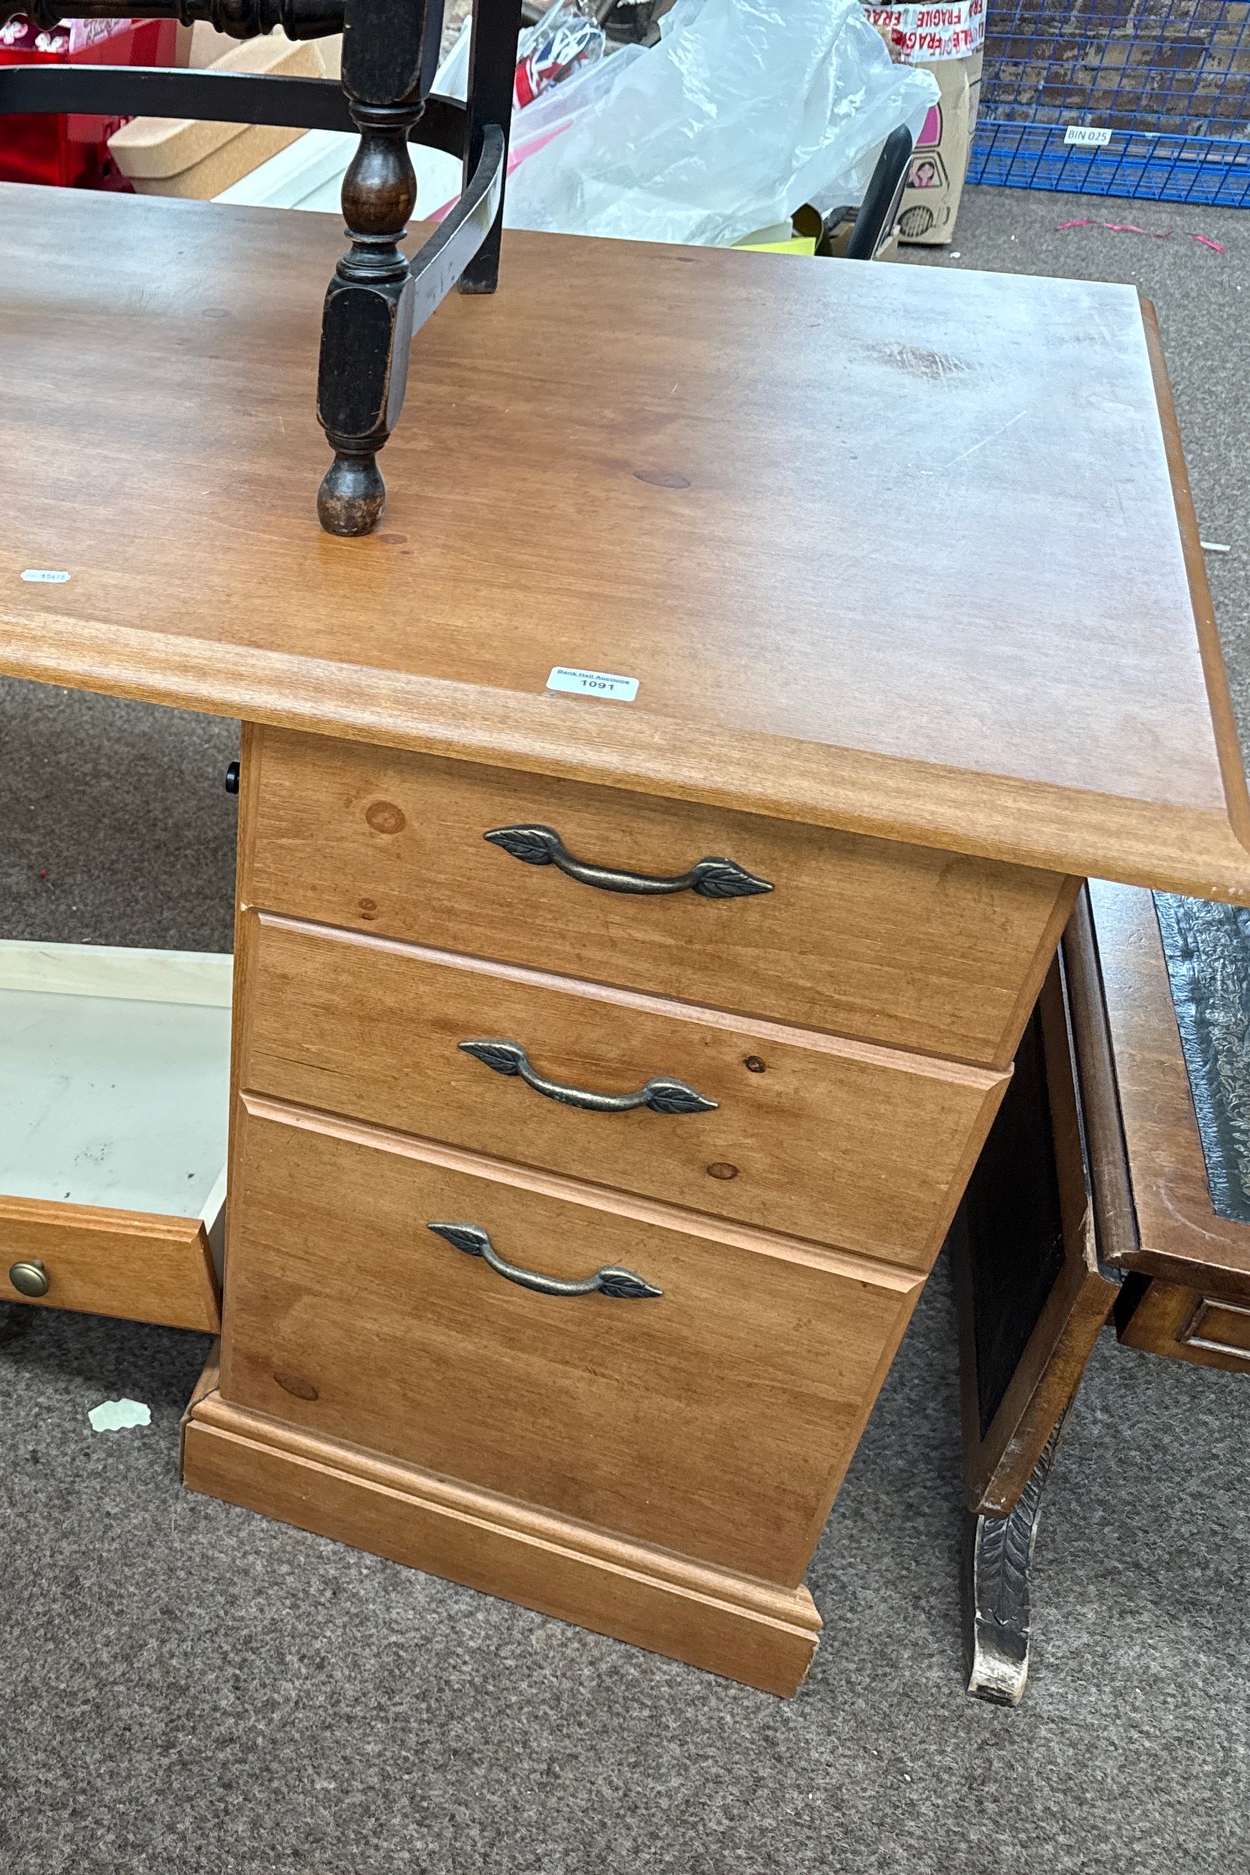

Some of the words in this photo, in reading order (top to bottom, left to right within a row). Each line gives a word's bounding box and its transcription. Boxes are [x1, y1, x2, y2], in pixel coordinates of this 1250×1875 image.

[917, 8, 961, 28] FRAGILE
[1067, 130, 1086, 141] BIN
[1088, 131, 1107, 142] 025
[581, 679, 615, 691] 1091
